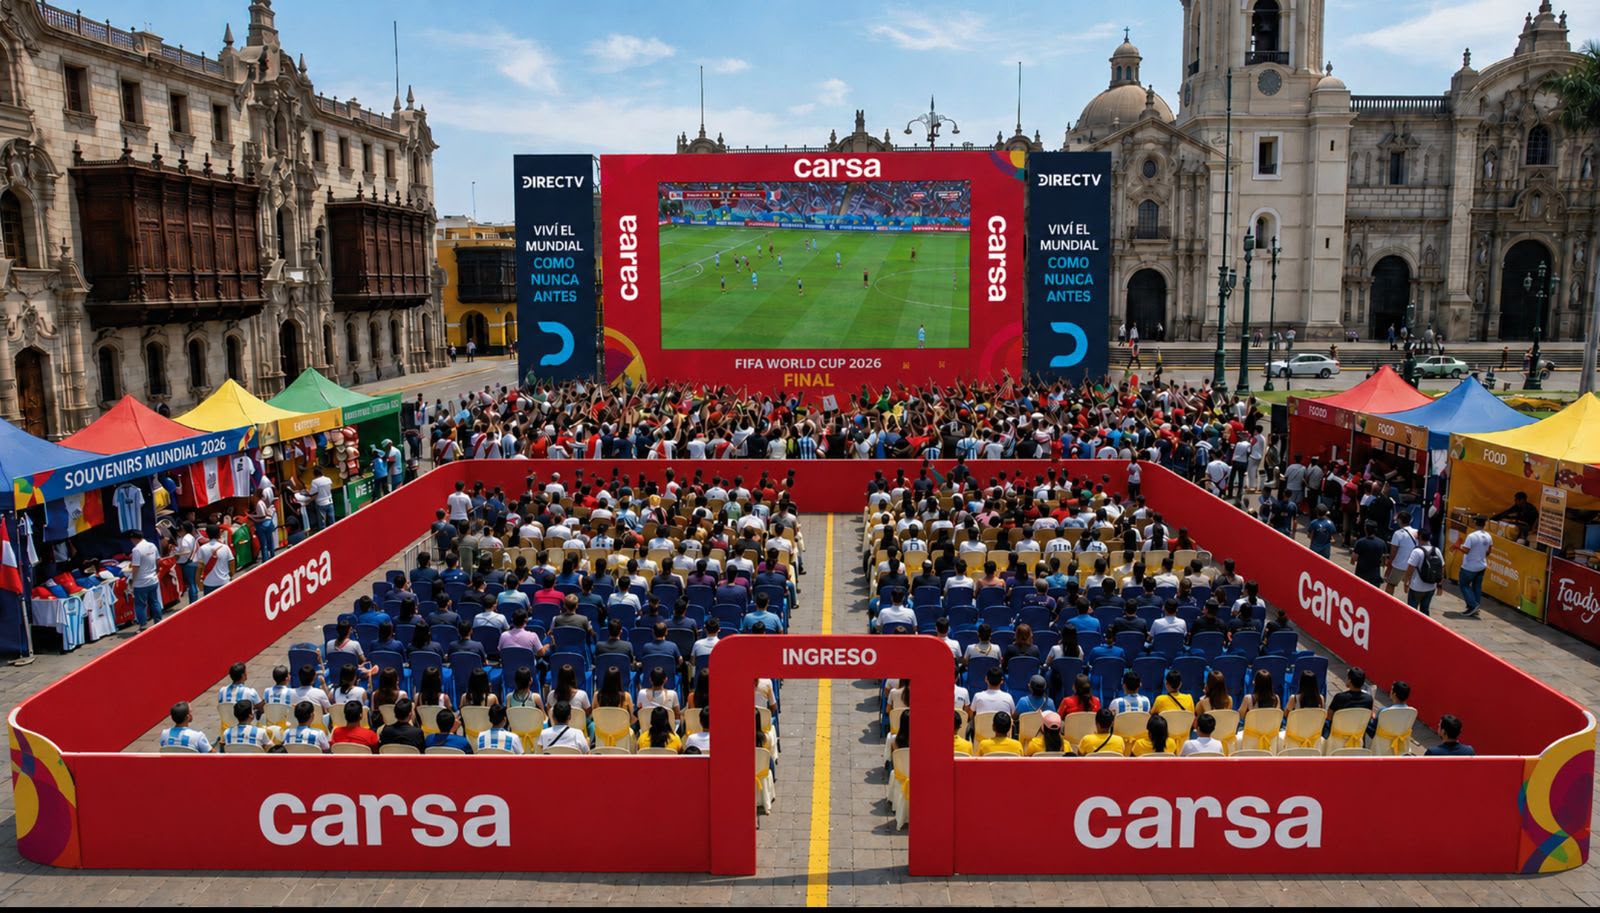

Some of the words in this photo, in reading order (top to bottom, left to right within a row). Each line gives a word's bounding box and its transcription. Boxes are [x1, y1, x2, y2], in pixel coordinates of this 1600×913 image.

[793, 158, 881, 178] carsa
[521, 175, 585, 189] DIRECTV
[1037, 173, 1102, 187] DIRECTV
[533, 222, 559, 236] VIVÍ
[560, 225, 576, 236] EL
[1048, 221, 1074, 235] VIVÍ
[1075, 224, 1091, 235] EL
[525, 240, 584, 252] MUNDIAL
[1040, 239, 1099, 251] MUNDIAL
[533, 256, 575, 269] COMO
[987, 215, 1007, 302] carsa
[1047, 256, 1090, 269] COMO
[531, 273, 580, 286] NUNCA
[1044, 273, 1094, 286] NUNCA
[533, 290, 577, 302] ANTES
[1046, 290, 1091, 303] ANTES
[735, 358, 764, 369] FIFA
[766, 358, 816, 369] WORLD
[818, 358, 846, 369] CUP
[849, 358, 882, 369] 2026
[783, 373, 834, 387] FINAL
[64, 456, 143, 490] SOUVENIRS
[145, 446, 199, 469] MUNDIAL
[201, 436, 227, 455] 2026
[1483, 448, 1507, 465] FOOD
[264, 550, 333, 621] carsa
[1298, 571, 1370, 650] carsa
[782, 648, 877, 666] INGRESO
[258, 792, 511, 847] carsa
[1073, 795, 1323, 849] carsa
